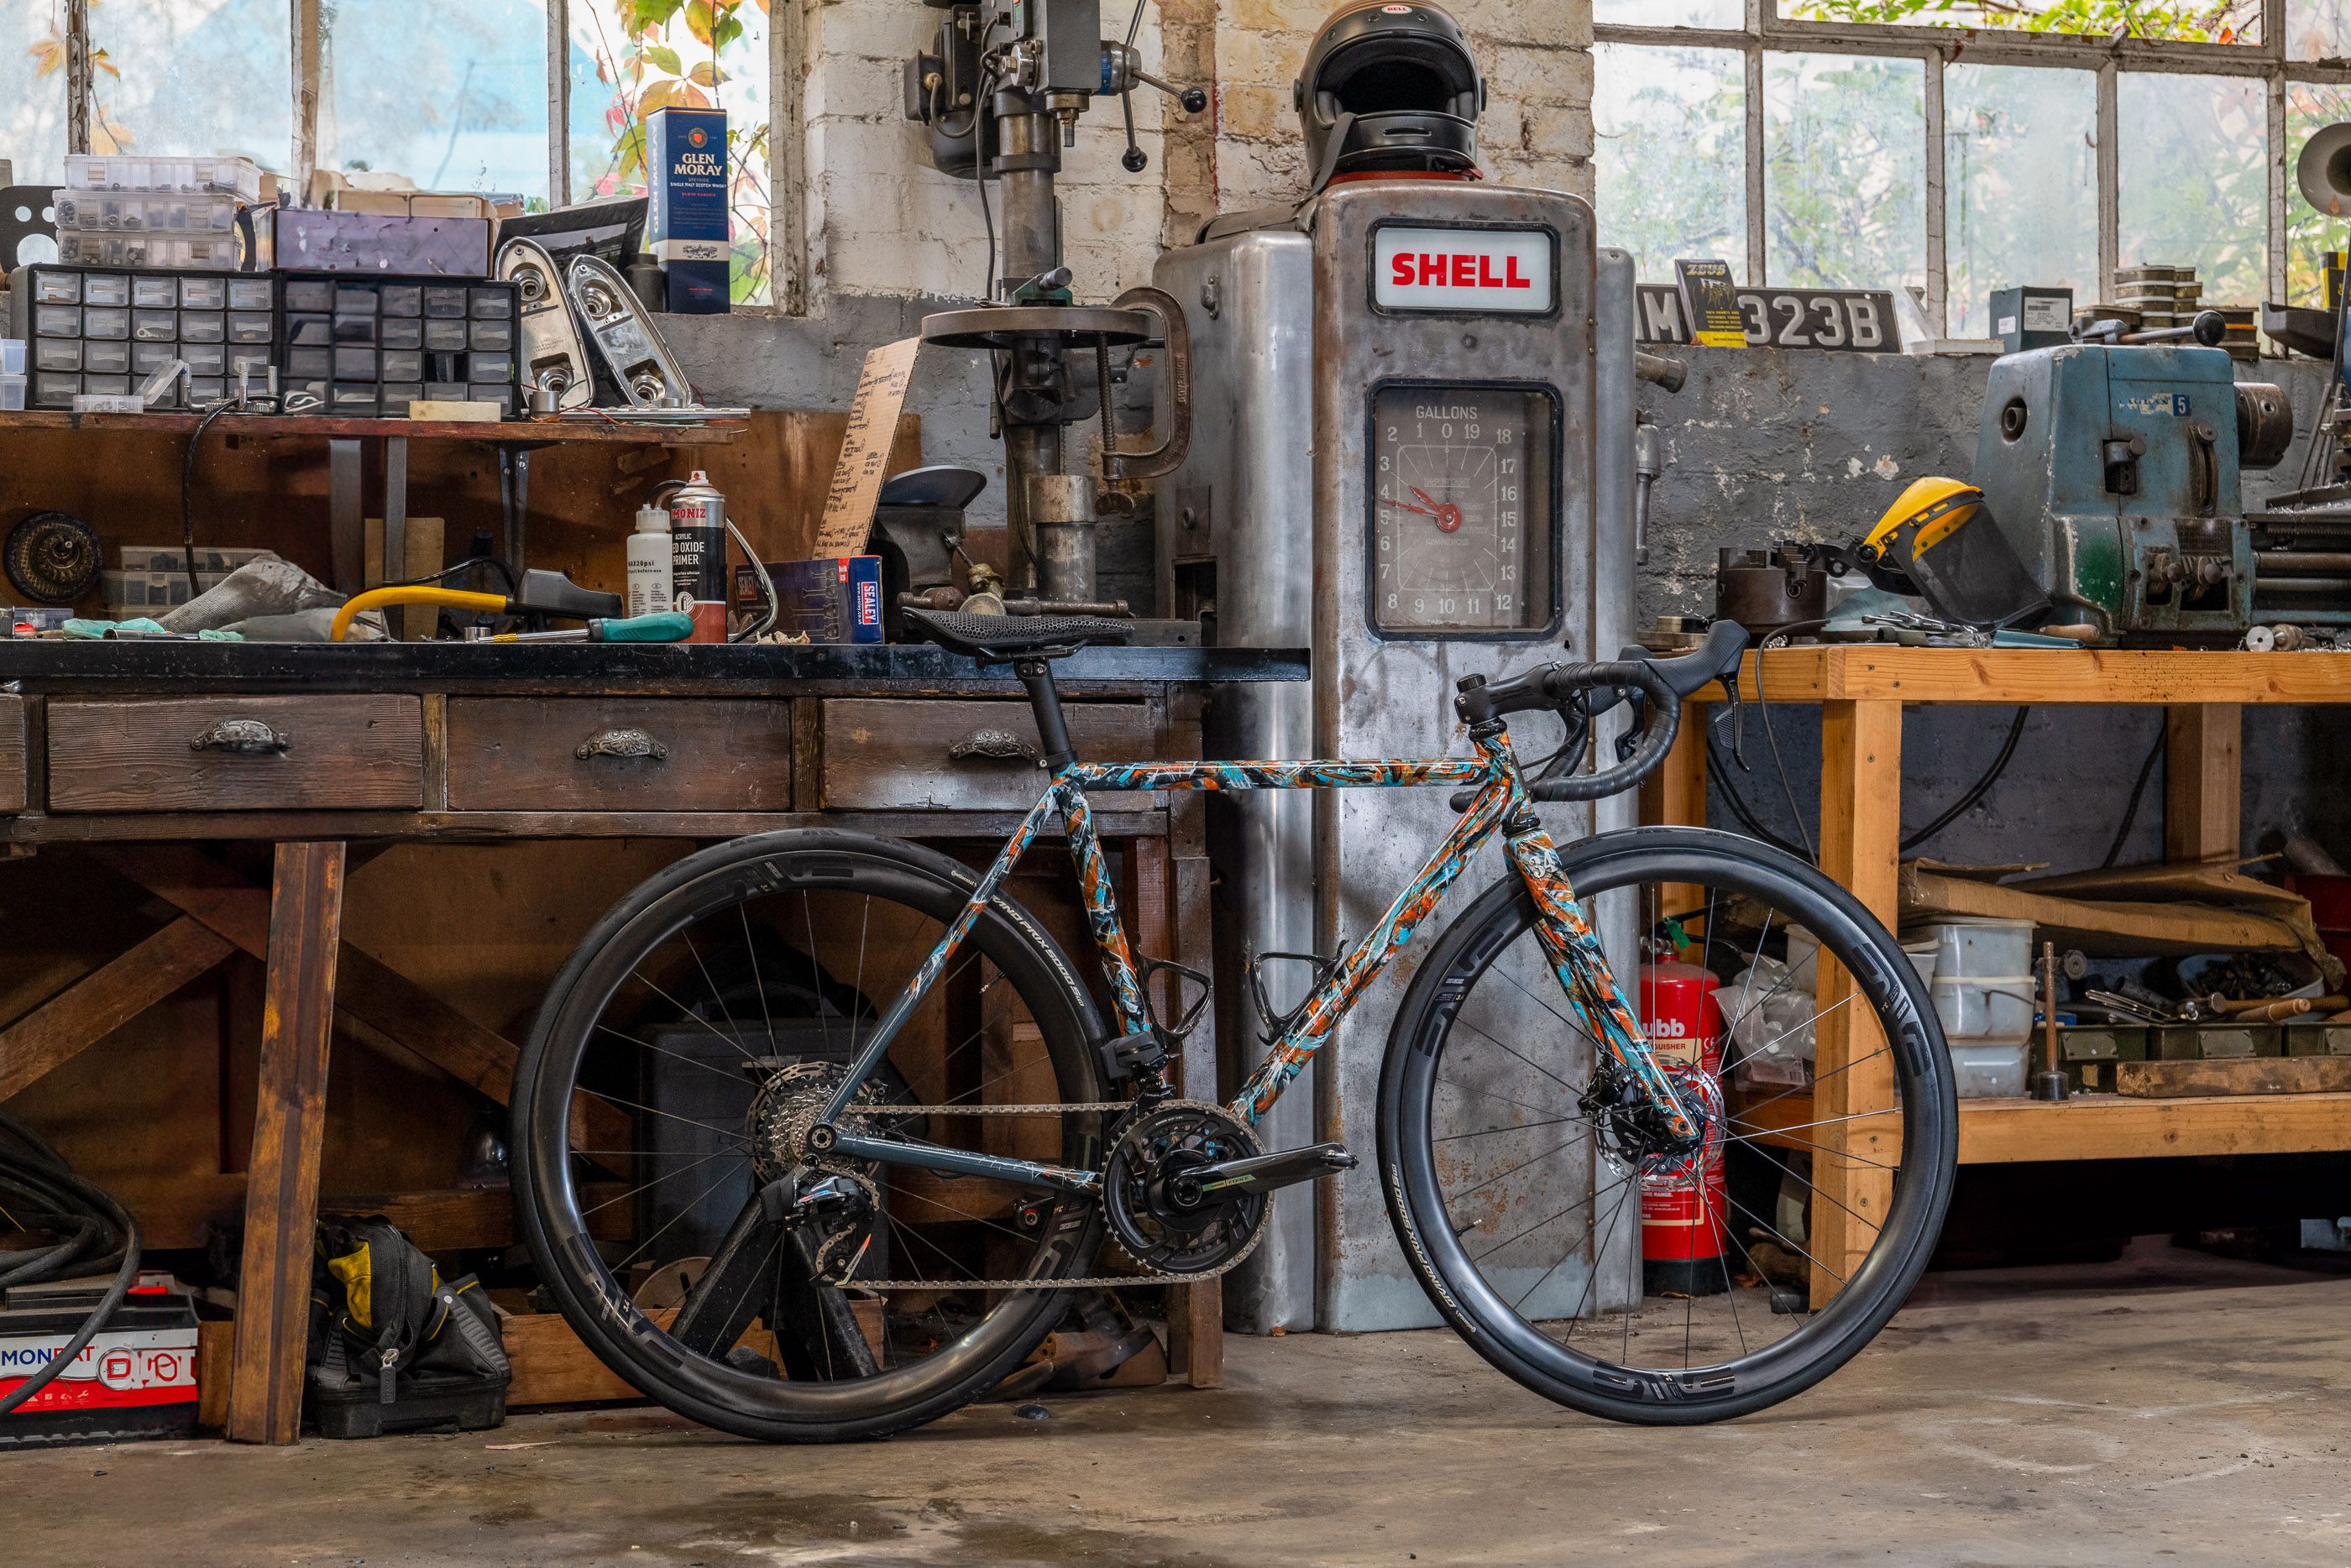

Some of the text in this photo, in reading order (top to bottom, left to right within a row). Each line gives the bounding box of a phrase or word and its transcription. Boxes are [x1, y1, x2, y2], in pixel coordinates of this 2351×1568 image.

[682, 153, 715, 165] GLEN
[674, 164, 723, 176] MORAY
[1391, 253, 1531, 288] SHELL
[1686, 264, 1726, 276] ZEUS
[1737, 295, 1882, 348] 323B
[1416, 405, 1478, 420] GALLONS
[2177, 396, 2186, 414] 5
[1388, 426, 1397, 442] 2
[1416, 423, 1423, 437] 1
[1442, 424, 1453, 438] 0
[1464, 424, 1479, 439] 19
[1496, 429, 1511, 443] 18
[1380, 456, 1390, 471] 3
[1501, 459, 1516, 474] 17
[1380, 484, 1390, 499] 4
[1501, 486, 1517, 501] 16
[1380, 511, 1390, 525] 5
[1501, 512, 1516, 527] 15
[680, 541, 704, 553] OXIDE
[1380, 536, 1390, 551] 6
[1501, 537, 1516, 552] 14
[673, 554, 699, 566] PRIMER
[1380, 563, 1390, 578] 7
[1501, 566, 1516, 581] 13
[864, 585, 876, 620] SEALEY
[1388, 593, 1398, 609] 8
[1415, 598, 1425, 614] 9
[1439, 598, 1455, 614] 10
[1467, 598, 1480, 614] 11
[1496, 595, 1511, 610] 12
[1528, 850, 1558, 879] 34
[950, 870, 974, 886] Continental
[1018, 921, 1050, 949] PRIX
[1045, 949, 1076, 985] 5000
[1394, 1188, 1412, 1230] 5000
[1406, 1230, 1428, 1265] PRIX
[1423, 1263, 1457, 1308] GRAND
[2, 1346, 95, 1366] MONT
